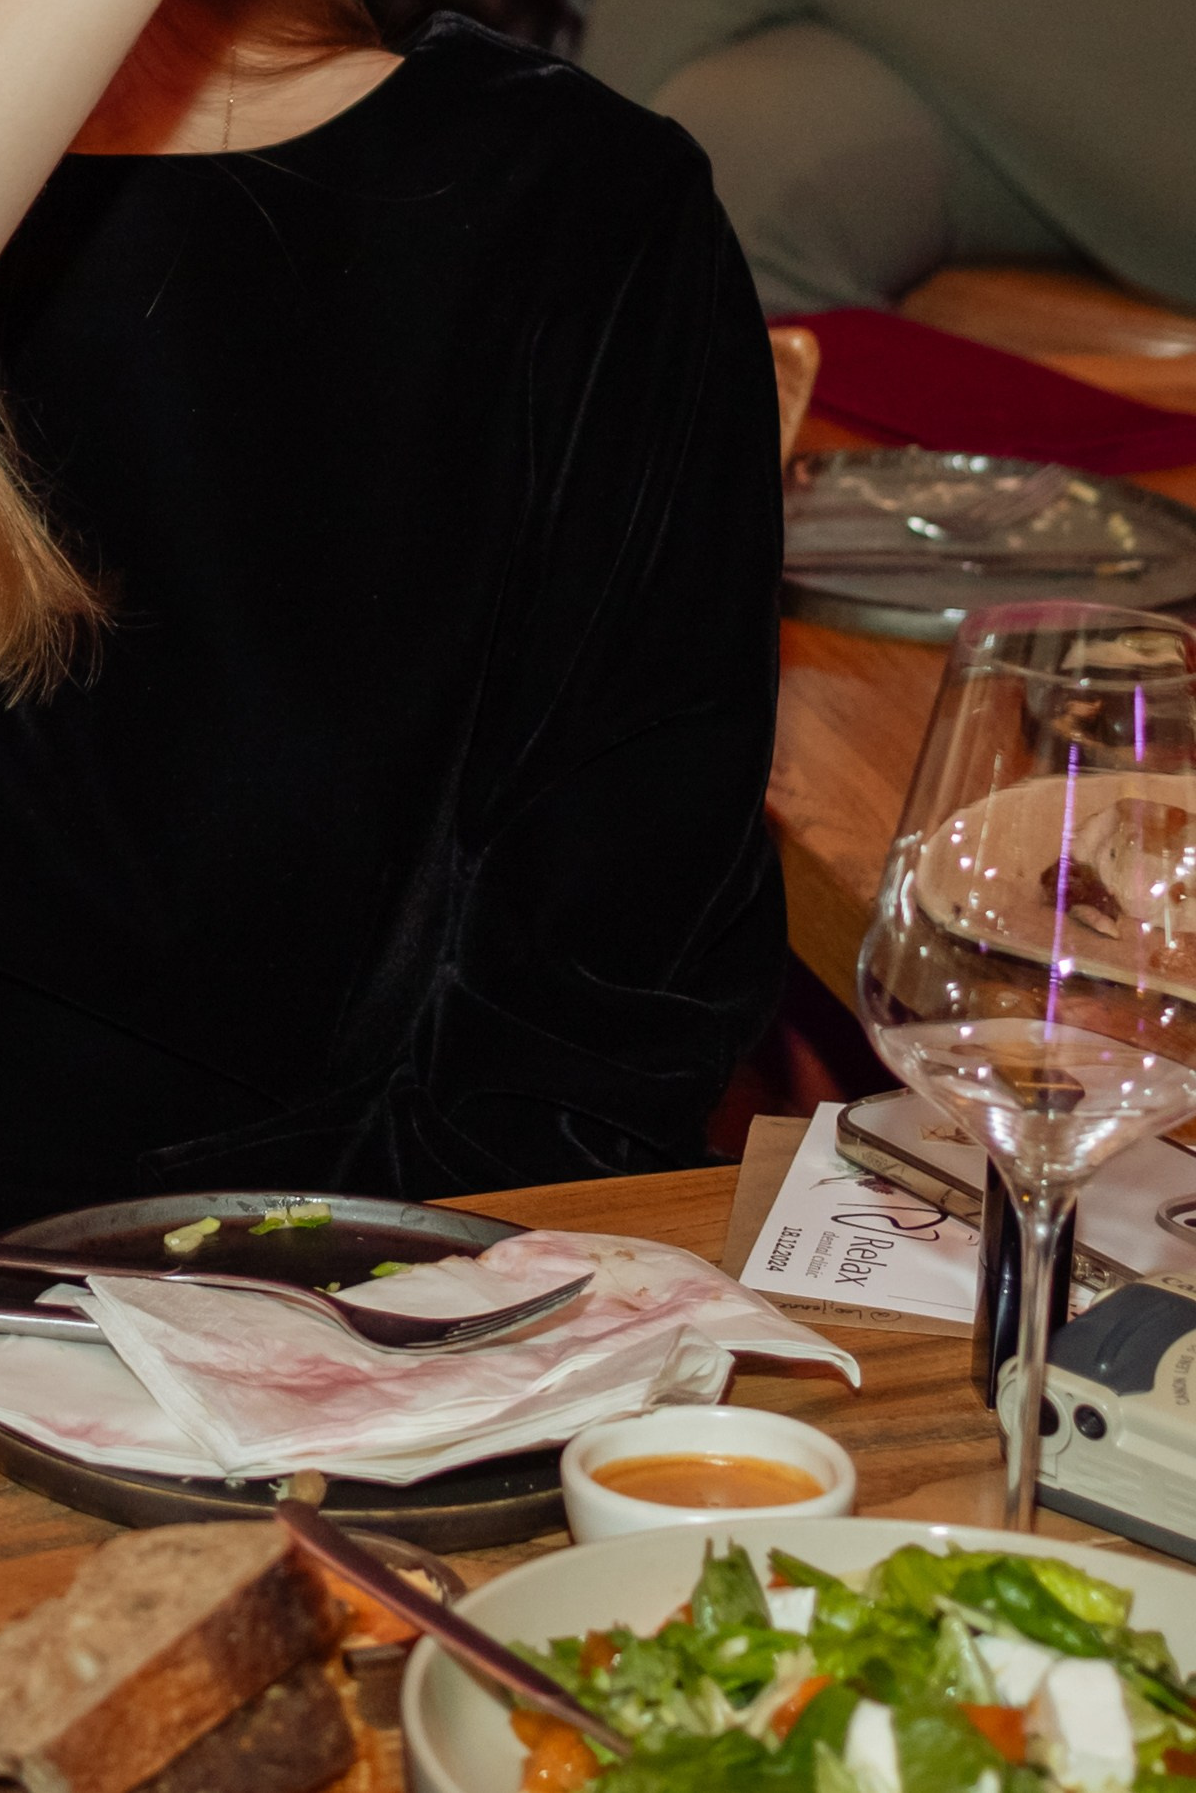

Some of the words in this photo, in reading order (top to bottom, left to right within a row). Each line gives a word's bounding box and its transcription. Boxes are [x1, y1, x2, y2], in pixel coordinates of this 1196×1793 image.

[766, 1226, 803, 1273] 18.12.2024
[817, 1230, 840, 1256] dental
[805, 1255, 829, 1279] clinic
[835, 1235, 895, 1288] Relax
[1161, 1276, 1196, 1294] Ca
[1171, 1377, 1191, 1406] CANON
